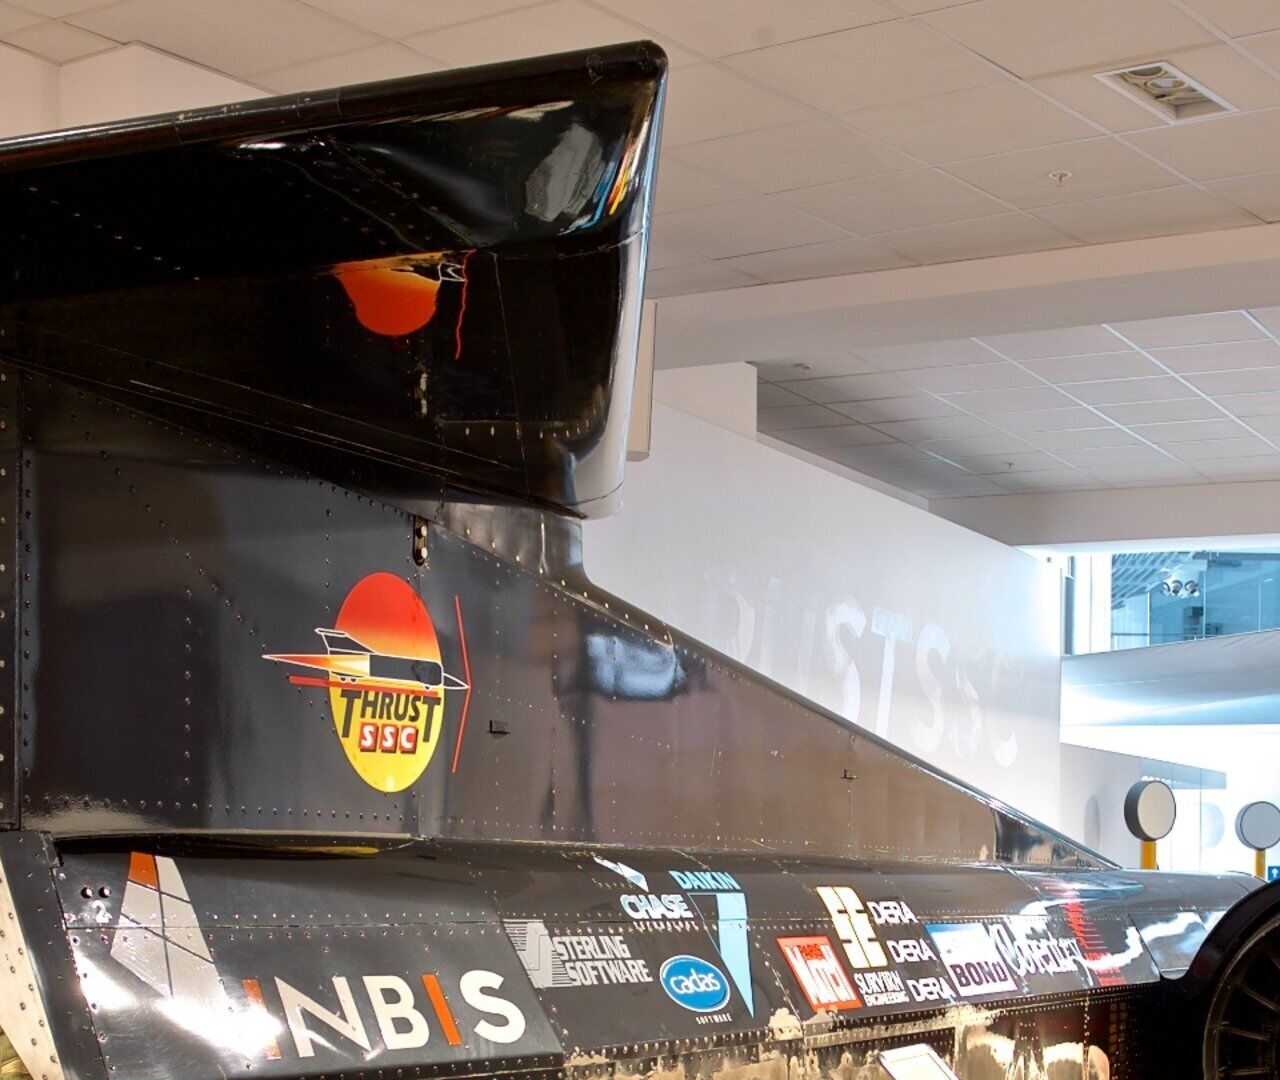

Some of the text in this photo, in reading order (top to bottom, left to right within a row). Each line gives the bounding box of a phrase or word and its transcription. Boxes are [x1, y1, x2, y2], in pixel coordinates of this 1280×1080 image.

[340, 688, 441, 742] THRUST
[360, 724, 417, 750] SSC
[669, 870, 742, 890] DAIKIN
[620, 894, 694, 919] CHASE
[866, 901, 919, 924] DERA
[552, 935, 632, 960] STERLING
[886, 939, 938, 963] DERA
[569, 959, 653, 986] SOFTWARE
[669, 968, 721, 995] cadas
[949, 961, 1009, 988] BOND
[906, 977, 957, 1002] DERA
